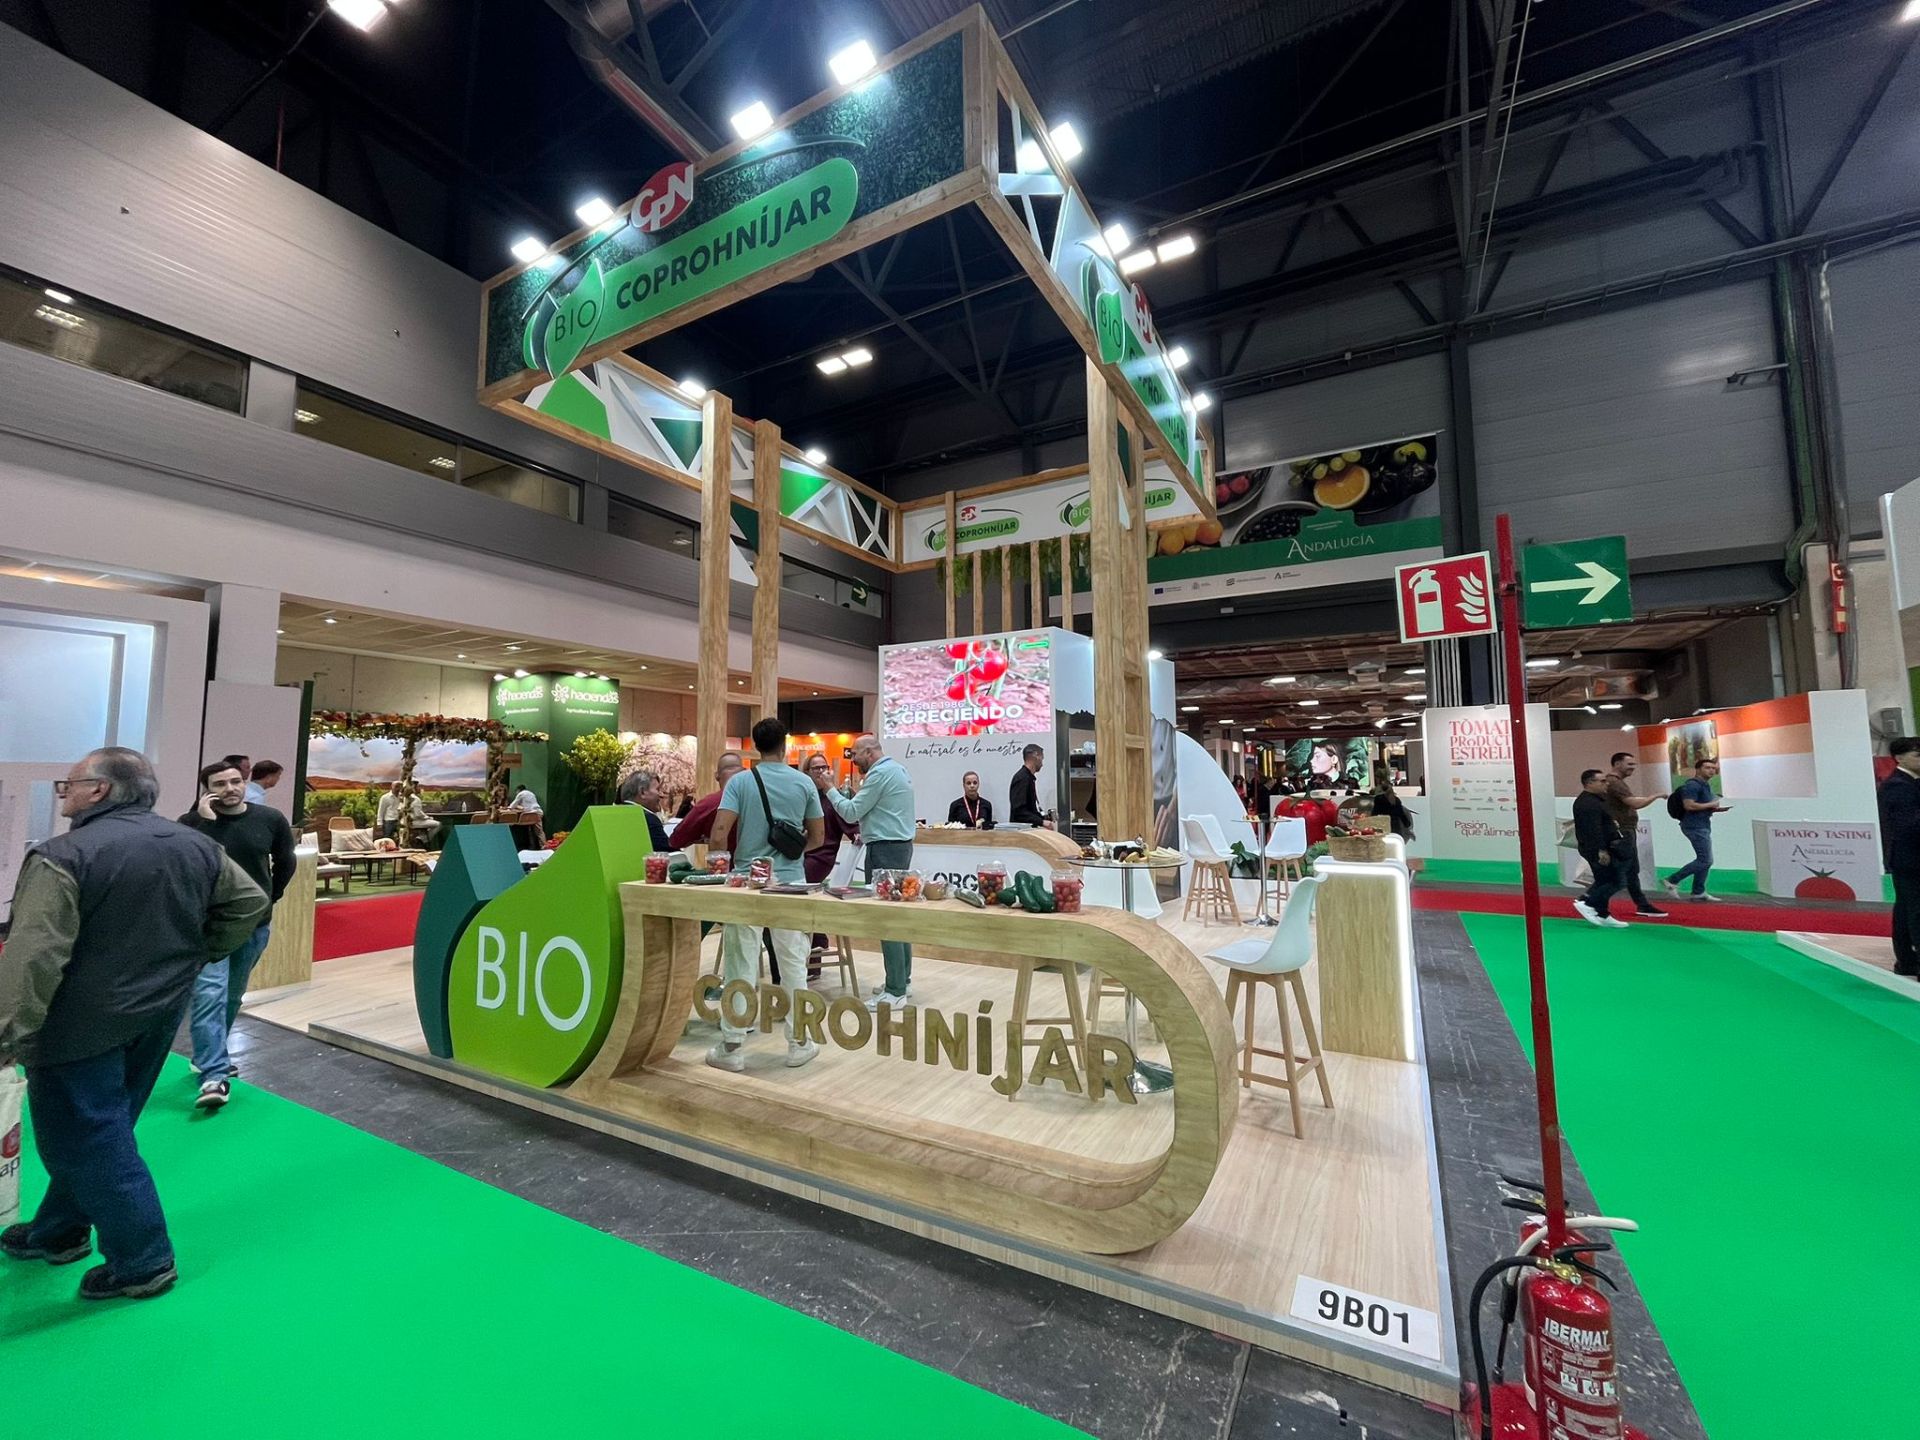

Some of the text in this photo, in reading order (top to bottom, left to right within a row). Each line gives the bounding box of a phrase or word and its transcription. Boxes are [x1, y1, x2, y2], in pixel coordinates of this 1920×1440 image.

[631, 164, 694, 231] CPN
[554, 184, 833, 343] BIO COPROHNÍJAR
[1101, 299, 1122, 348] BIO
[1287, 534, 1375, 561] ANDALUCÍA
[901, 704, 1024, 724] CRECIENDO
[959, 746, 969, 757] es
[1450, 735, 1511, 747] PRODUCT
[1454, 820, 1488, 829] Pasión
[1460, 827, 1482, 838] que
[1825, 830, 1872, 840] TASTING
[476, 926, 1138, 1105] BIO COPROHNÍJAR
[1318, 1289, 1409, 1344] 9B01
